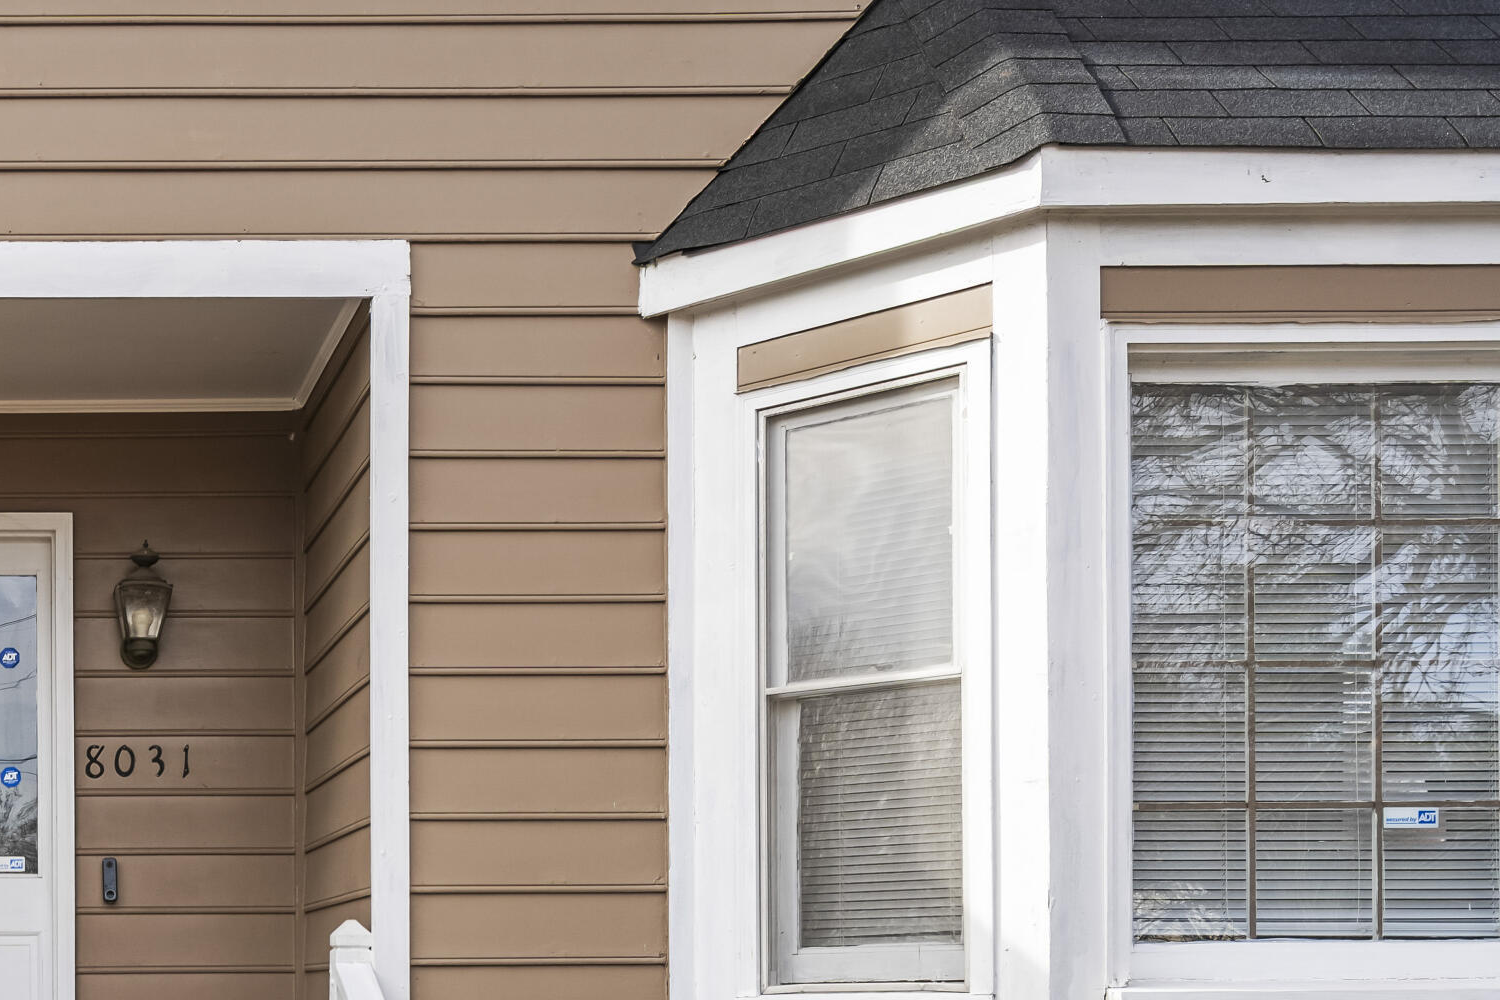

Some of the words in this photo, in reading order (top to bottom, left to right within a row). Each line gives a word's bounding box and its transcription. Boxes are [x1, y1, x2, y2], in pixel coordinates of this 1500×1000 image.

[2, 653, 18, 661] ADT
[85, 744, 190, 779] 8031
[3, 771, 19, 780] ADT
[1418, 812, 1436, 822] ADT
